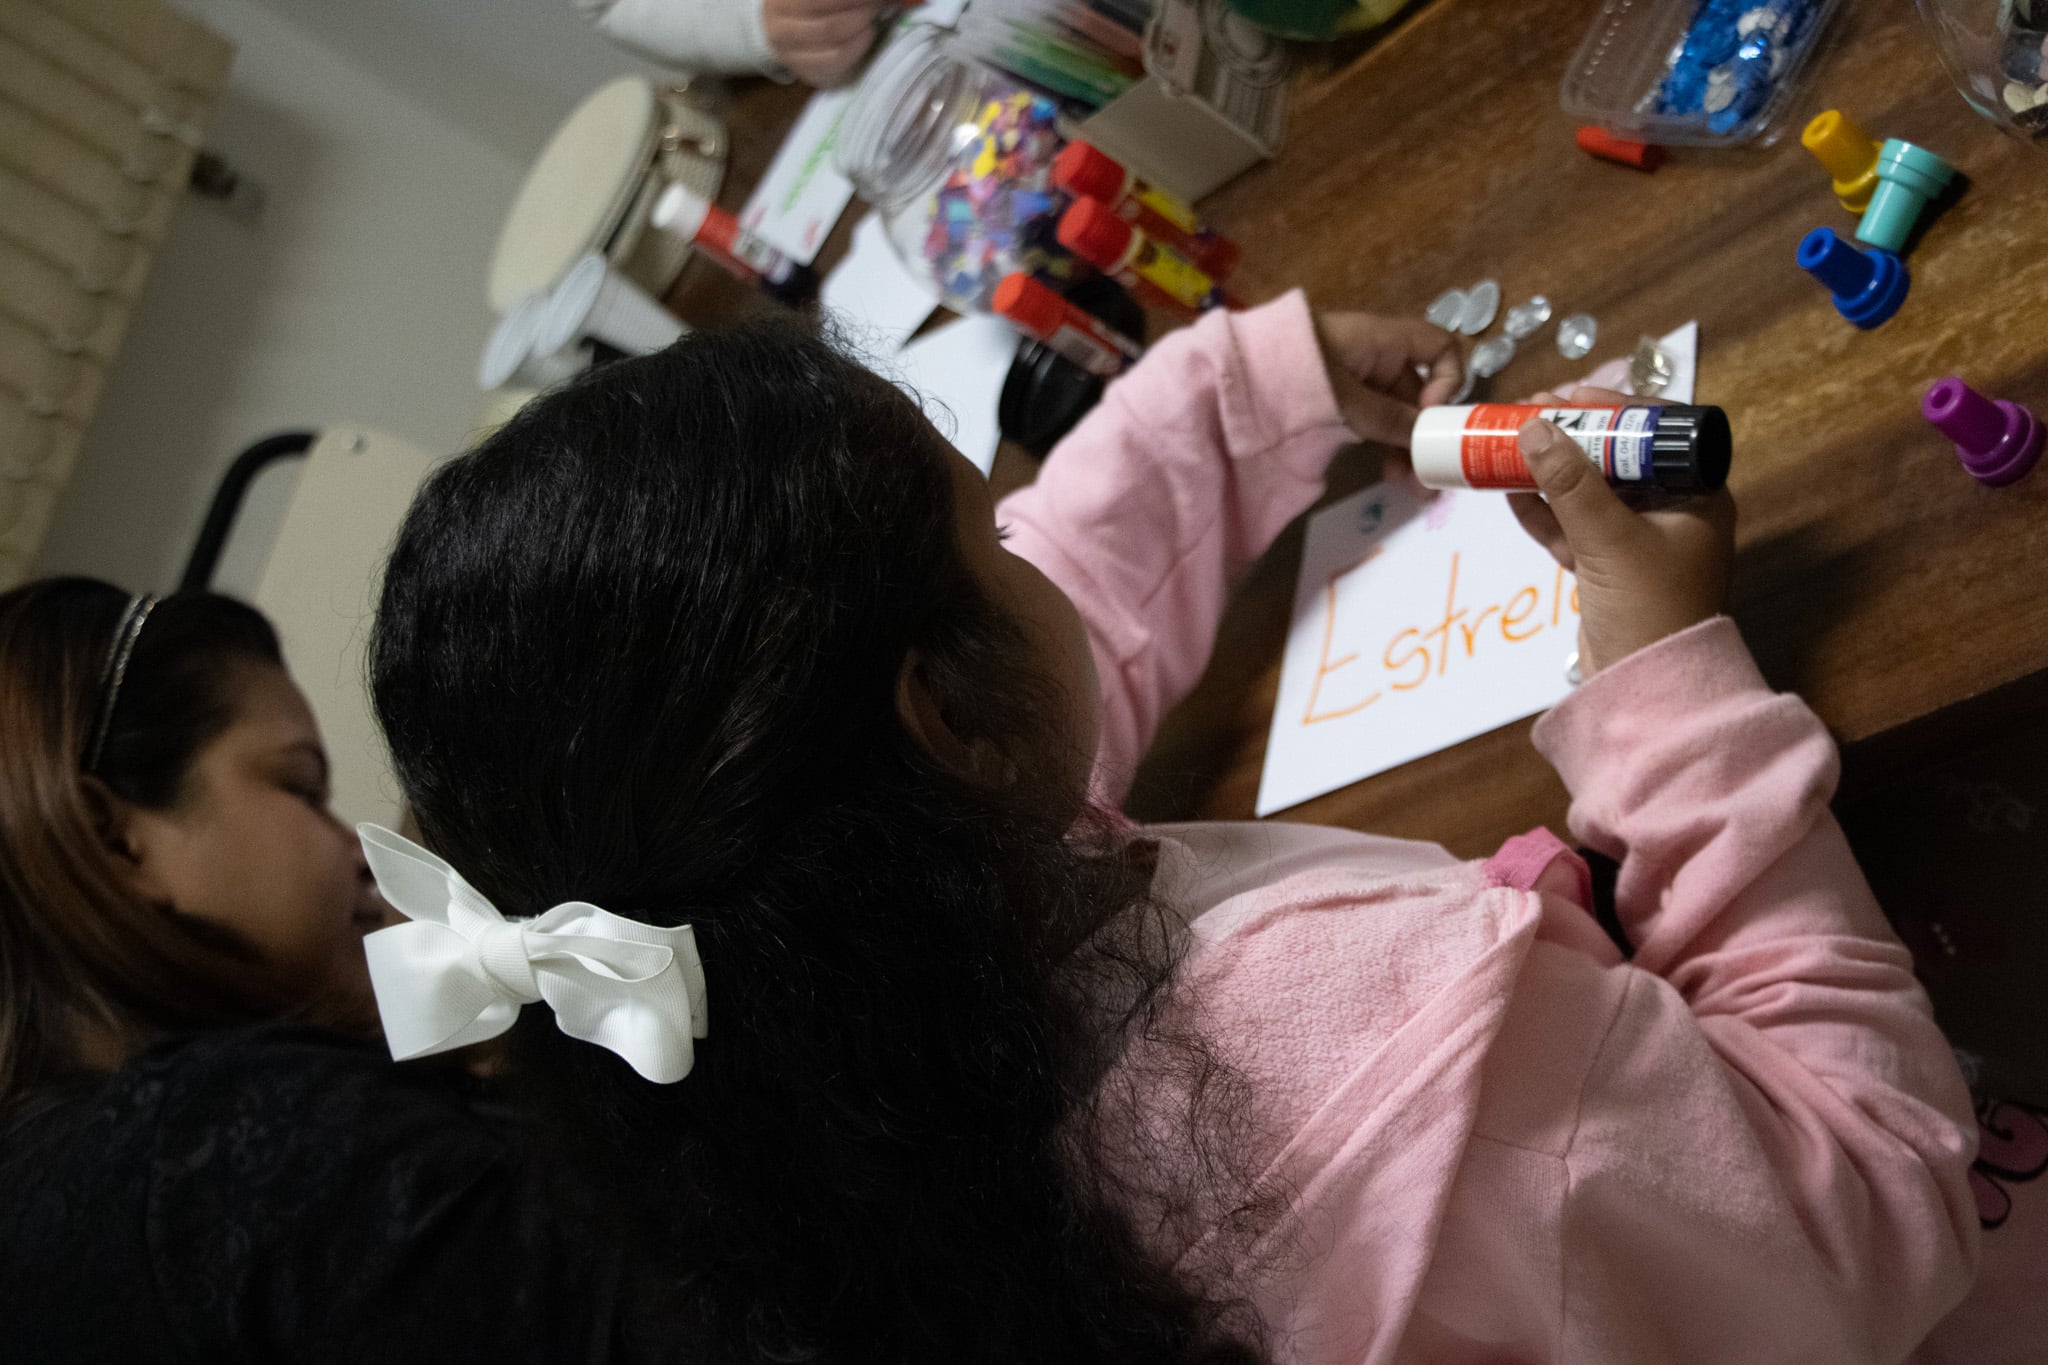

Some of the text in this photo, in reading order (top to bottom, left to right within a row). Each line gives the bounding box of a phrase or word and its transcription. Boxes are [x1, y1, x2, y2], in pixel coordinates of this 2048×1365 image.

[1620, 412, 1638, 454] 04/026
[1619, 457, 1630, 475] val.
[1302, 545, 1580, 727] Estrel
